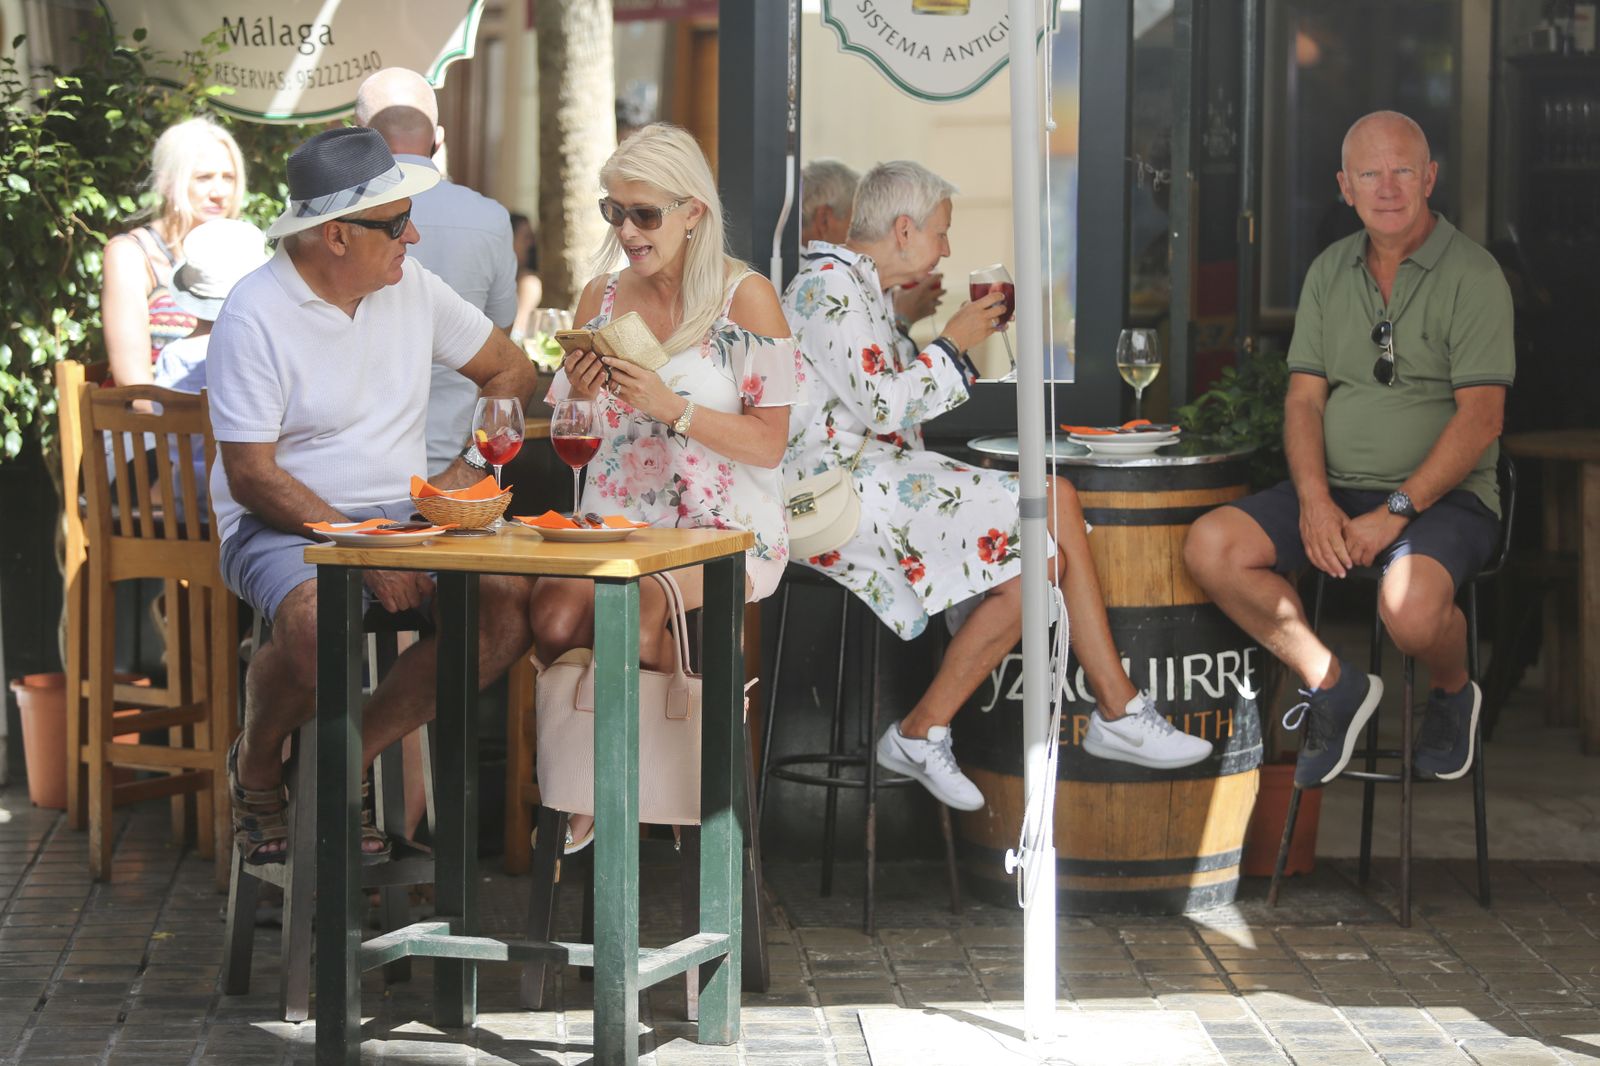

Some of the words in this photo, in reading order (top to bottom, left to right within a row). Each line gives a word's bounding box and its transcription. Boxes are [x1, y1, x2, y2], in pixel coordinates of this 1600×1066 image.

[221, 16, 335, 55] Málaga
[857, 0, 931, 61] SISTEMA
[943, 14, 1009, 62] ANTIG
[297, 50, 383, 90] 952222340
